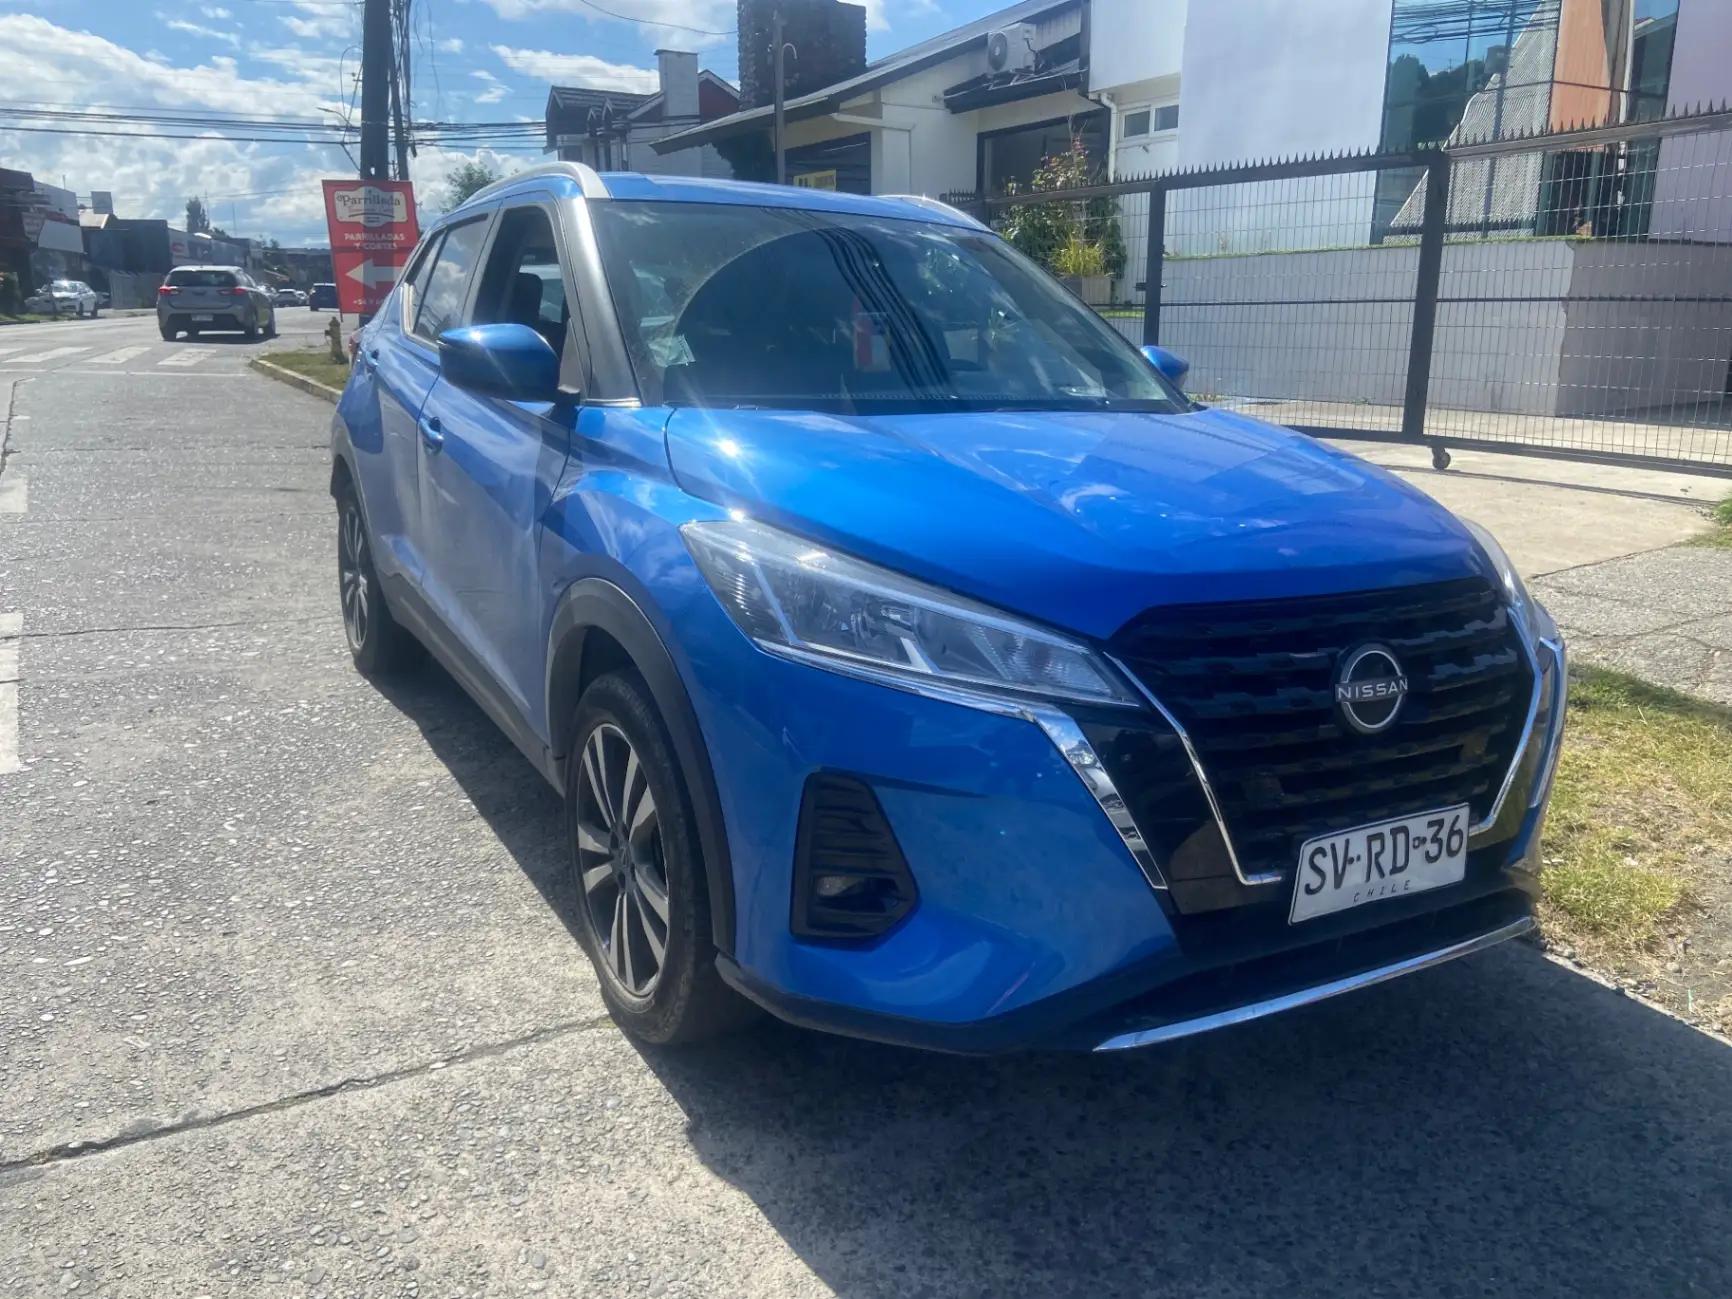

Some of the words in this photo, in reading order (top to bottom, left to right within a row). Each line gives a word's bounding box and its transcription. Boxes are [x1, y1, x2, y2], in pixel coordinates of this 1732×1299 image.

[344, 232, 405, 241] PARRILLADAS
[1338, 678, 1408, 700] NISSAN
[1353, 879, 1411, 904] CHILE
